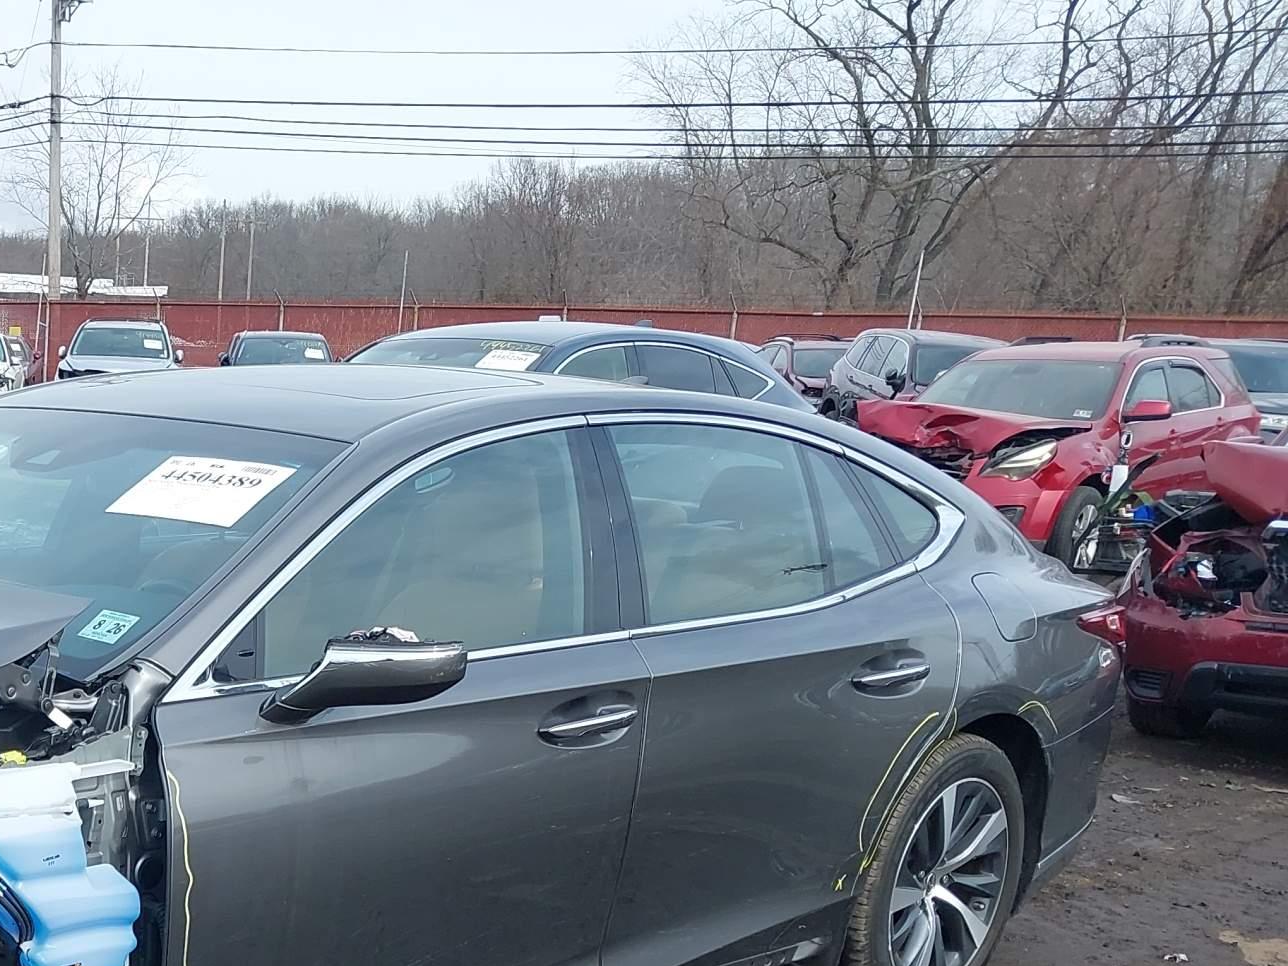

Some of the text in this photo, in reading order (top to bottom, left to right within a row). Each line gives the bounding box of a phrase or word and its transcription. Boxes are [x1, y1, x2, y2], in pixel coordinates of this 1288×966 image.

[161, 470, 262, 488] 44504389
[92, 619, 107, 630] 8
[105, 622, 127, 635] 26
